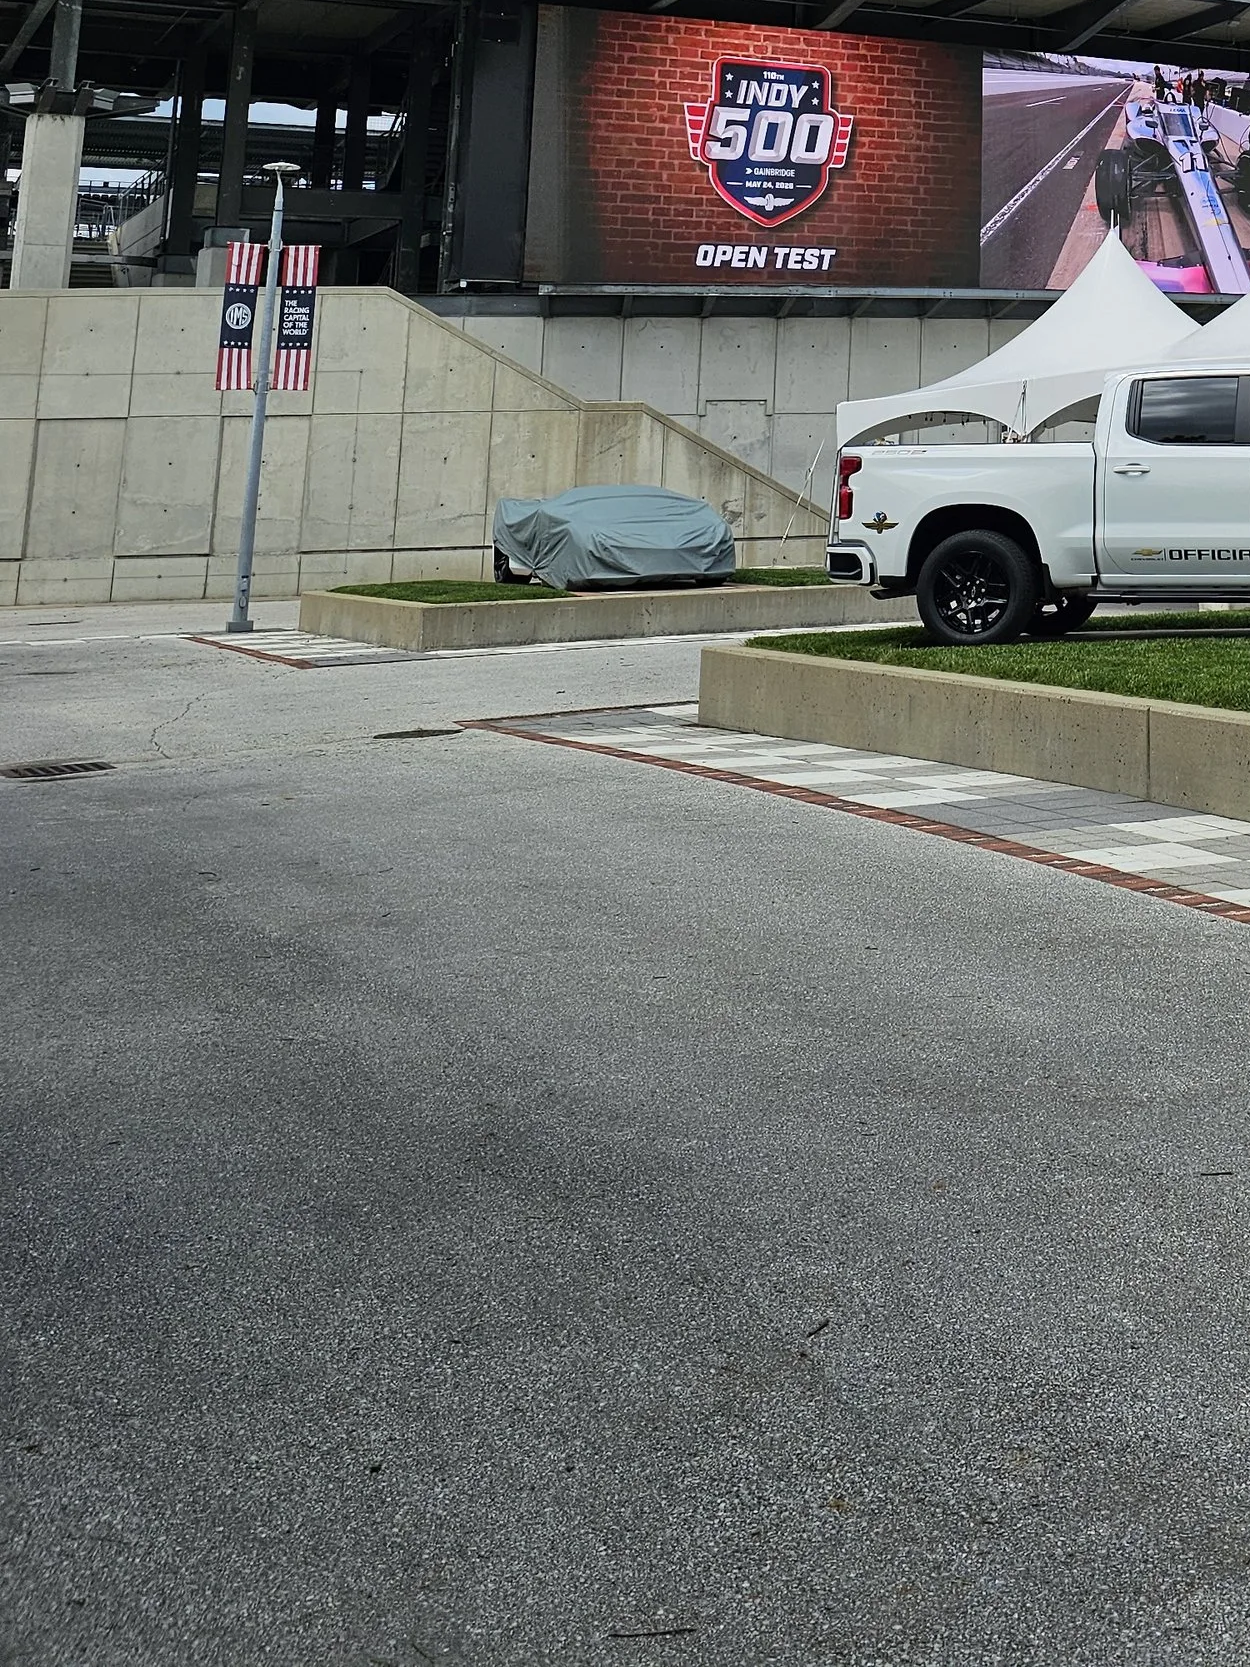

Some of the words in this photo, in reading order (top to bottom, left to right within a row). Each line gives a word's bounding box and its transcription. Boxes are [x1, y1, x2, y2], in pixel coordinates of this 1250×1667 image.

[736, 79, 809, 109] INDY
[704, 106, 835, 165] 500
[1179, 152, 1209, 173] 11
[695, 244, 768, 269] OPEN
[774, 247, 836, 271] TEST
[285, 299, 298, 307] THE
[230, 306, 248, 326] IMS
[283, 321, 294, 329] OF
